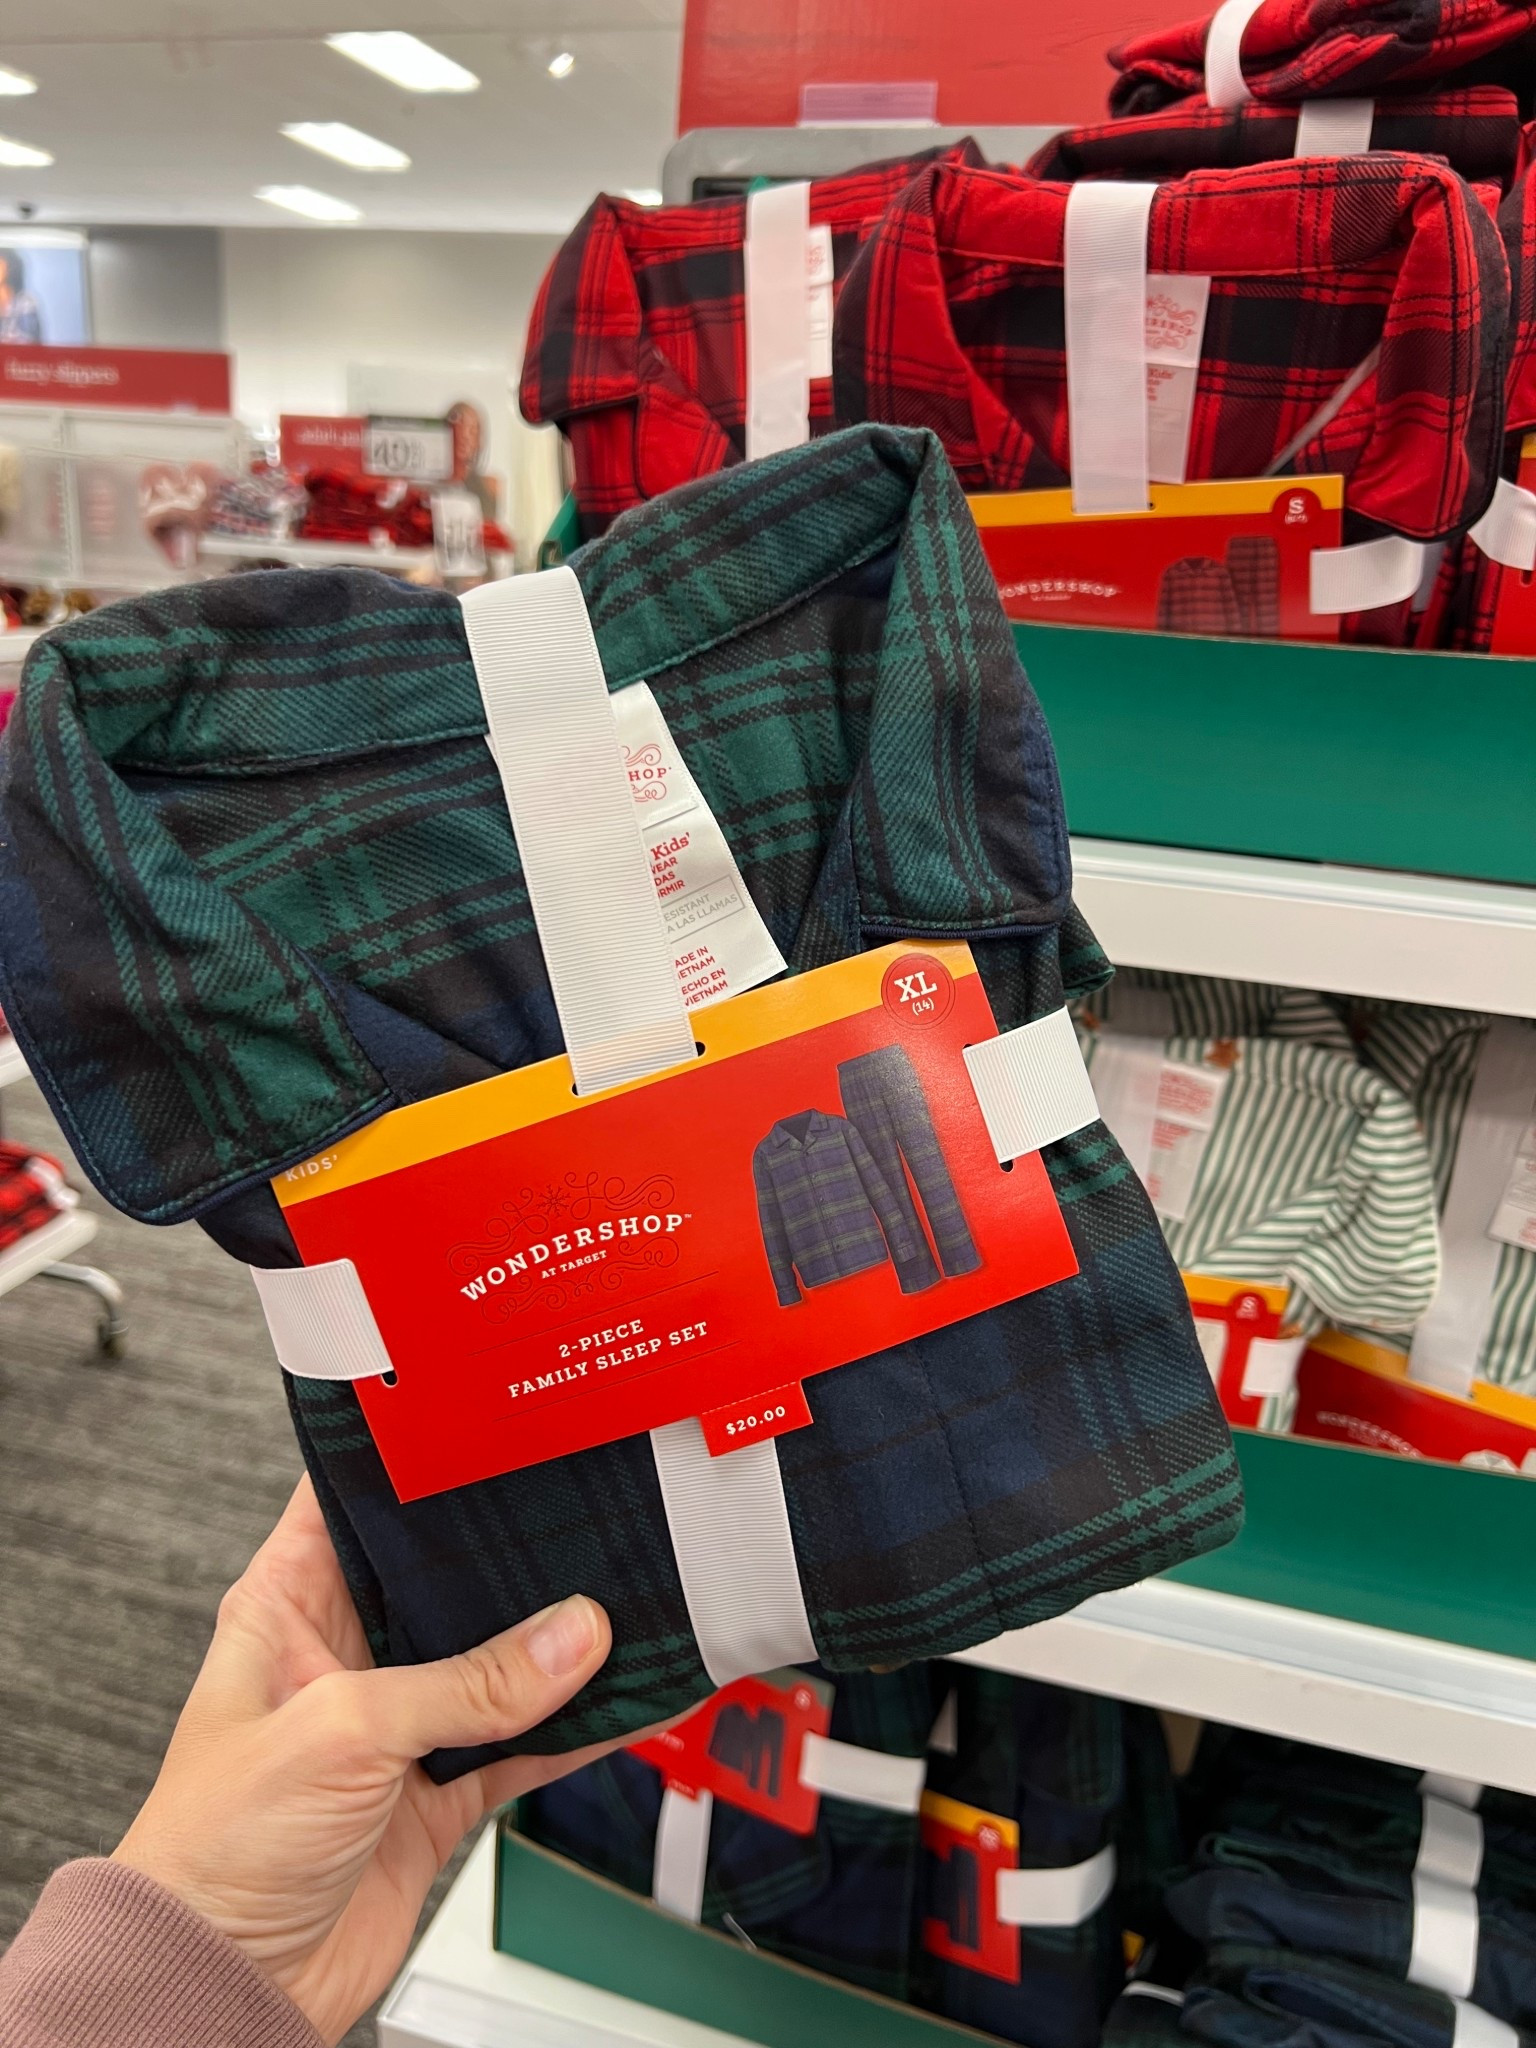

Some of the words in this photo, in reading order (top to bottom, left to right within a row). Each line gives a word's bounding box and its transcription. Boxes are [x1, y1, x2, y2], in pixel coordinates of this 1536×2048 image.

[1288, 496, 1305, 514] S
[628, 767, 668, 782] HOP
[650, 831, 690, 861] Kids'
[654, 871, 676, 887] DAS
[658, 879, 686, 899] RMIR
[663, 893, 710, 922] ESISTANT
[667, 925, 676, 934] A
[675, 914, 696, 929] LAS
[696, 893, 738, 919] LLAMAS
[675, 952, 697, 969] ADE
[696, 945, 709, 957] IN
[681, 976, 709, 995] ECHO
[710, 967, 726, 981] EN
[893, 970, 938, 1003] XL
[912, 997, 935, 1017] (14)
[284, 1154, 338, 1182] KIDS'
[541, 1266, 557, 1279] AT
[560, 1249, 608, 1272] TARGET
[558, 1318, 645, 1358] 2-PIECE
[507, 1361, 589, 1399] FAMILY
[595, 1337, 662, 1371] SLEEP
[668, 1320, 709, 1347] SET
[725, 1405, 786, 1436] $20.00
